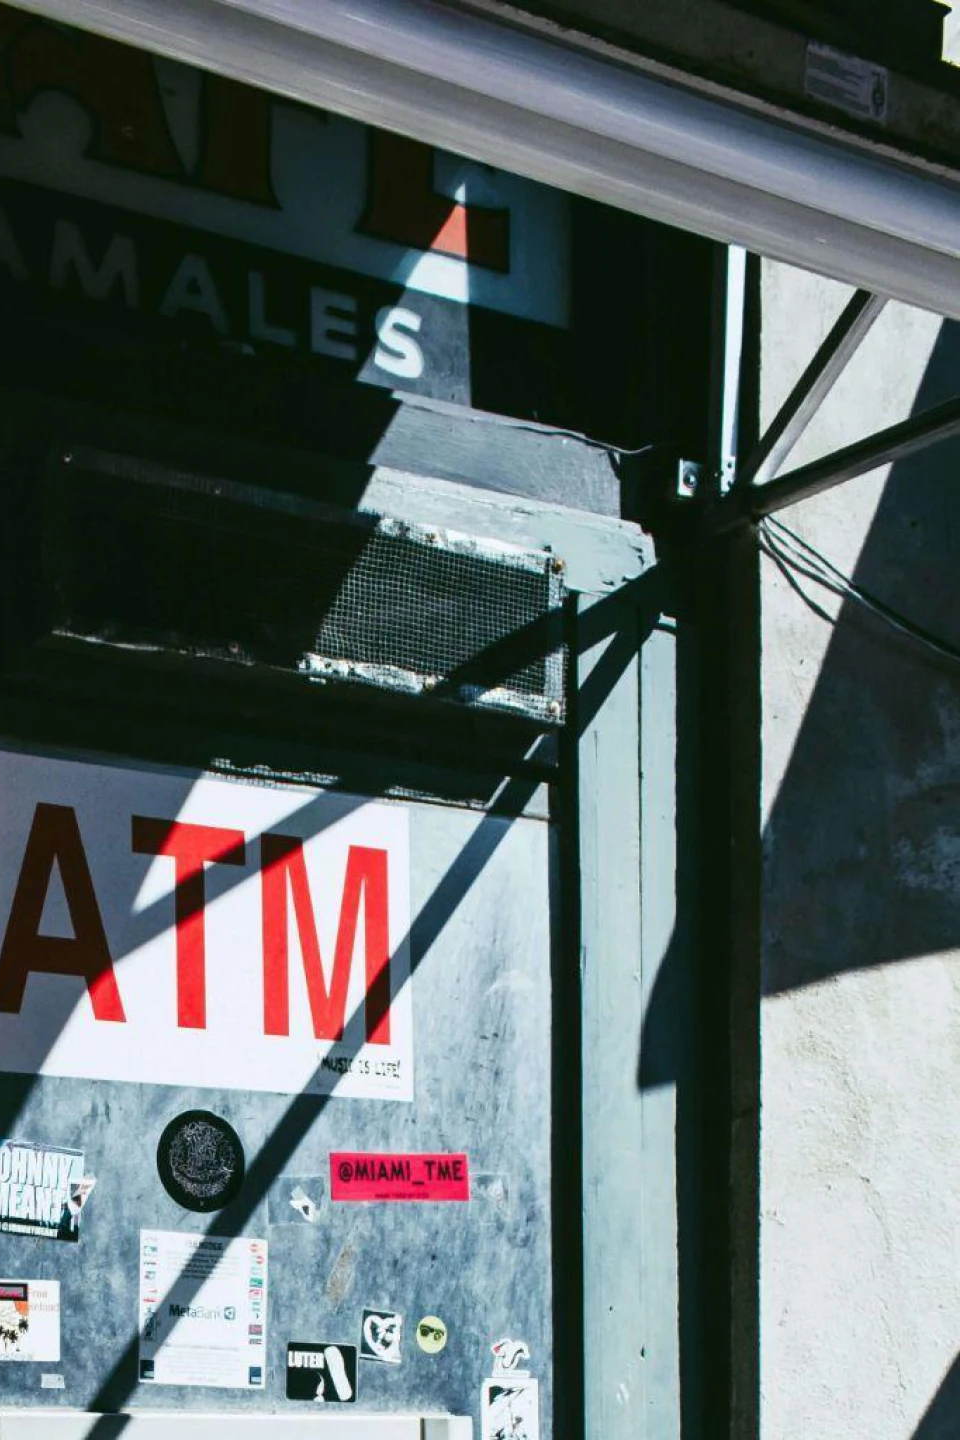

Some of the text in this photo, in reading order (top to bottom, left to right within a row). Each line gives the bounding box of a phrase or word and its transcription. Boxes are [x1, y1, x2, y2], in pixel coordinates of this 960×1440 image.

[320, 1056, 353, 1074] MUSIC
[358, 1060, 370, 1074] IS
[337, 1160, 464, 1186] @MIAMI_TME
